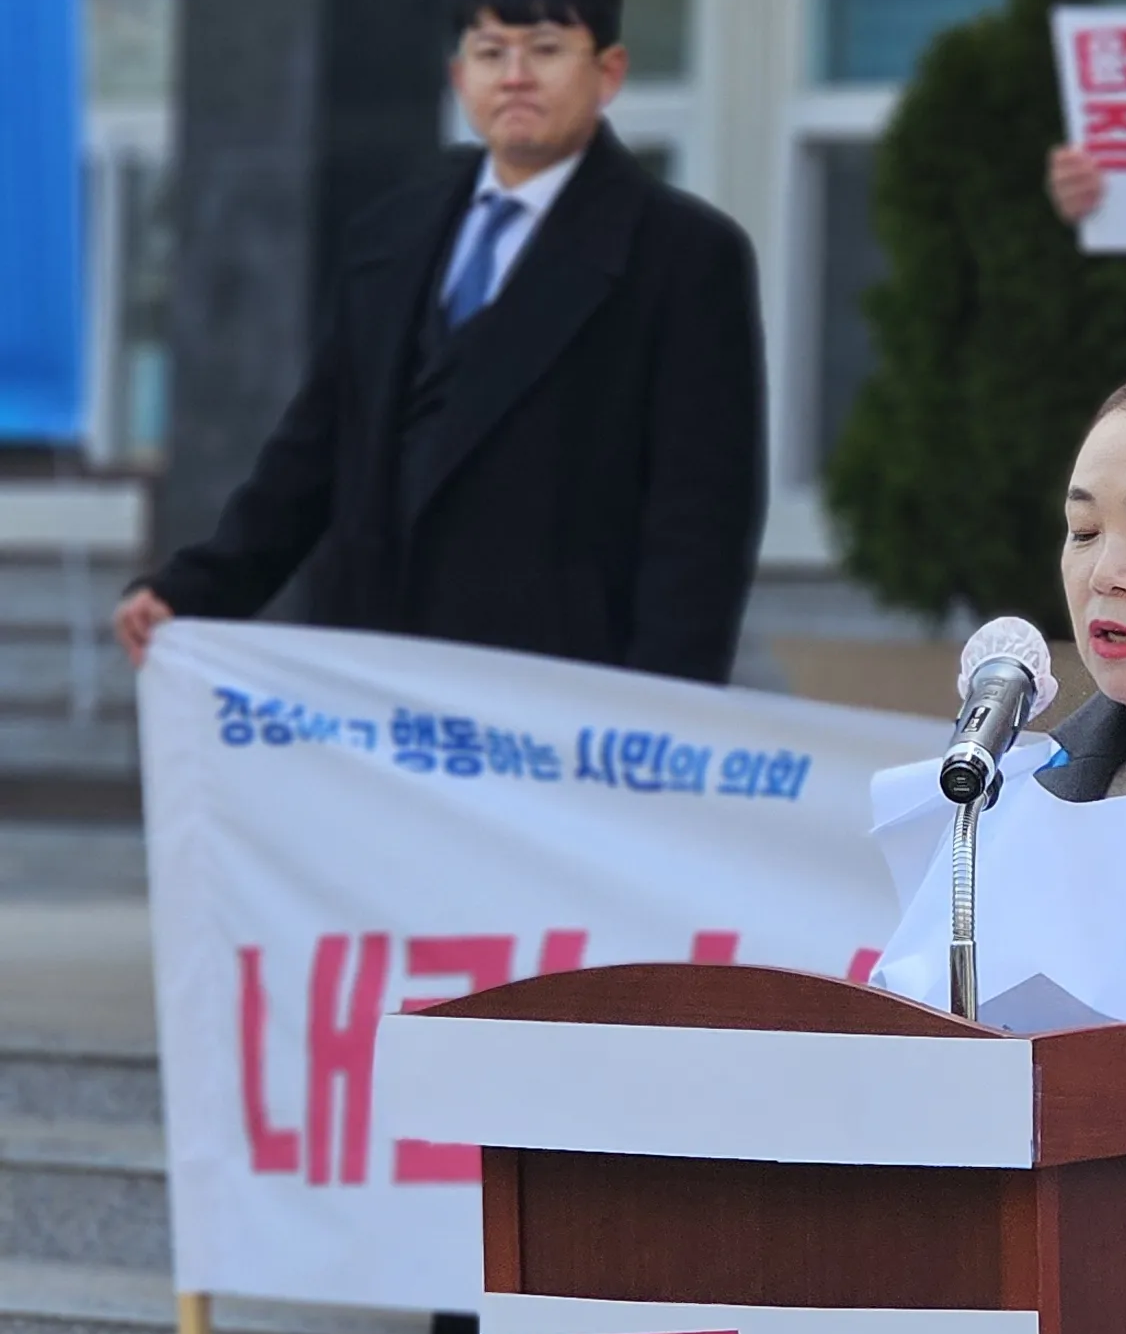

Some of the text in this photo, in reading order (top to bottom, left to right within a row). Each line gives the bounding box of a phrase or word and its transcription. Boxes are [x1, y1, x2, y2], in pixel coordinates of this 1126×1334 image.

[391, 708, 562, 780] 행동하는
[574, 727, 708, 794] 시민의
[717, 748, 813, 801] 의회
